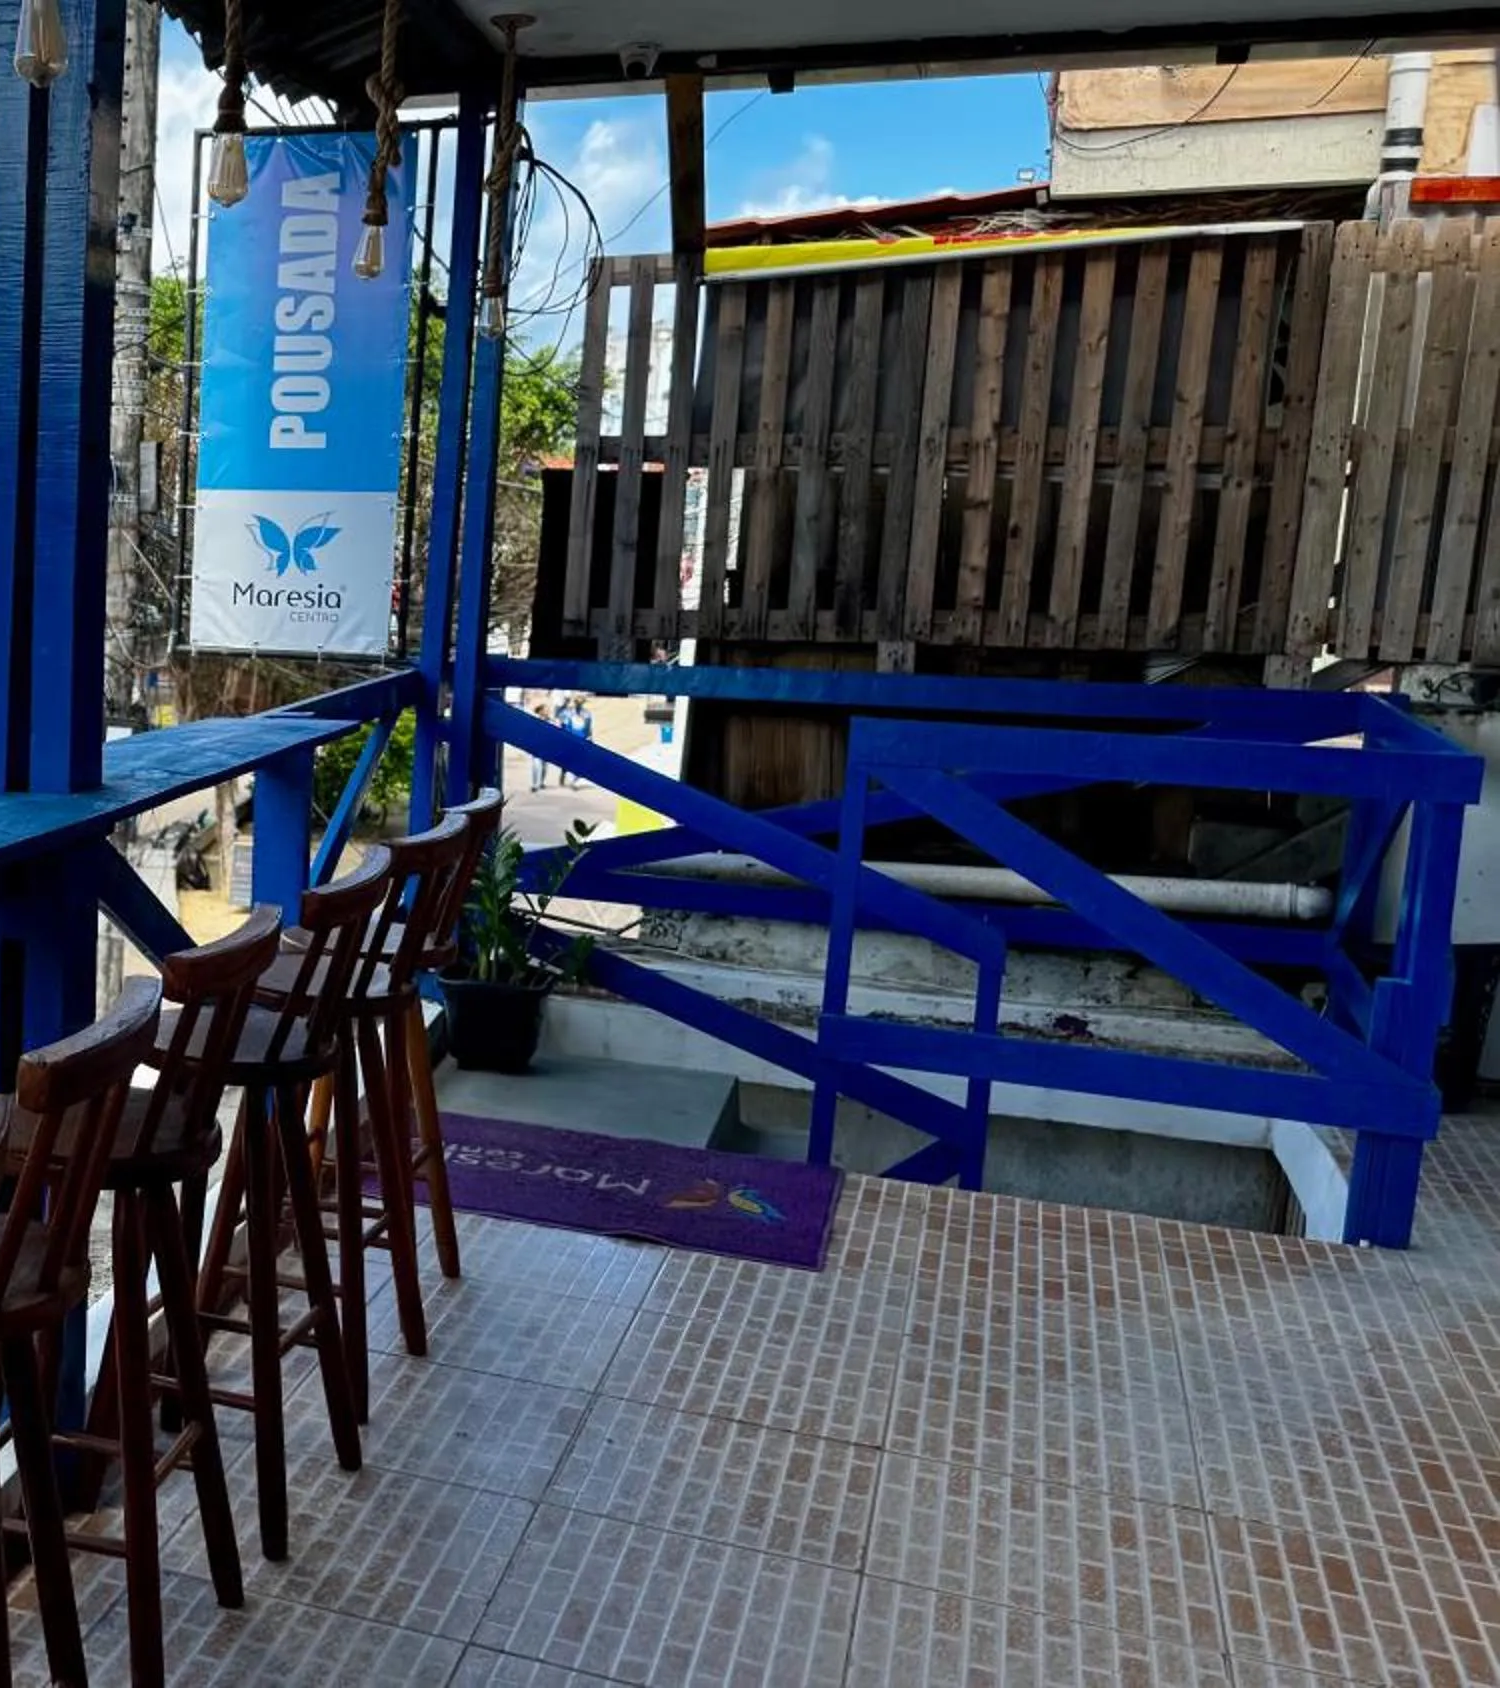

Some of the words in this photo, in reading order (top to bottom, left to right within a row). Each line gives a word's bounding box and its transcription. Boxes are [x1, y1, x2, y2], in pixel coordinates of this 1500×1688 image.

[269, 171, 341, 449] POUSADA
[233, 582, 342, 609] Maresia
[289, 612, 340, 624] CENTRO
